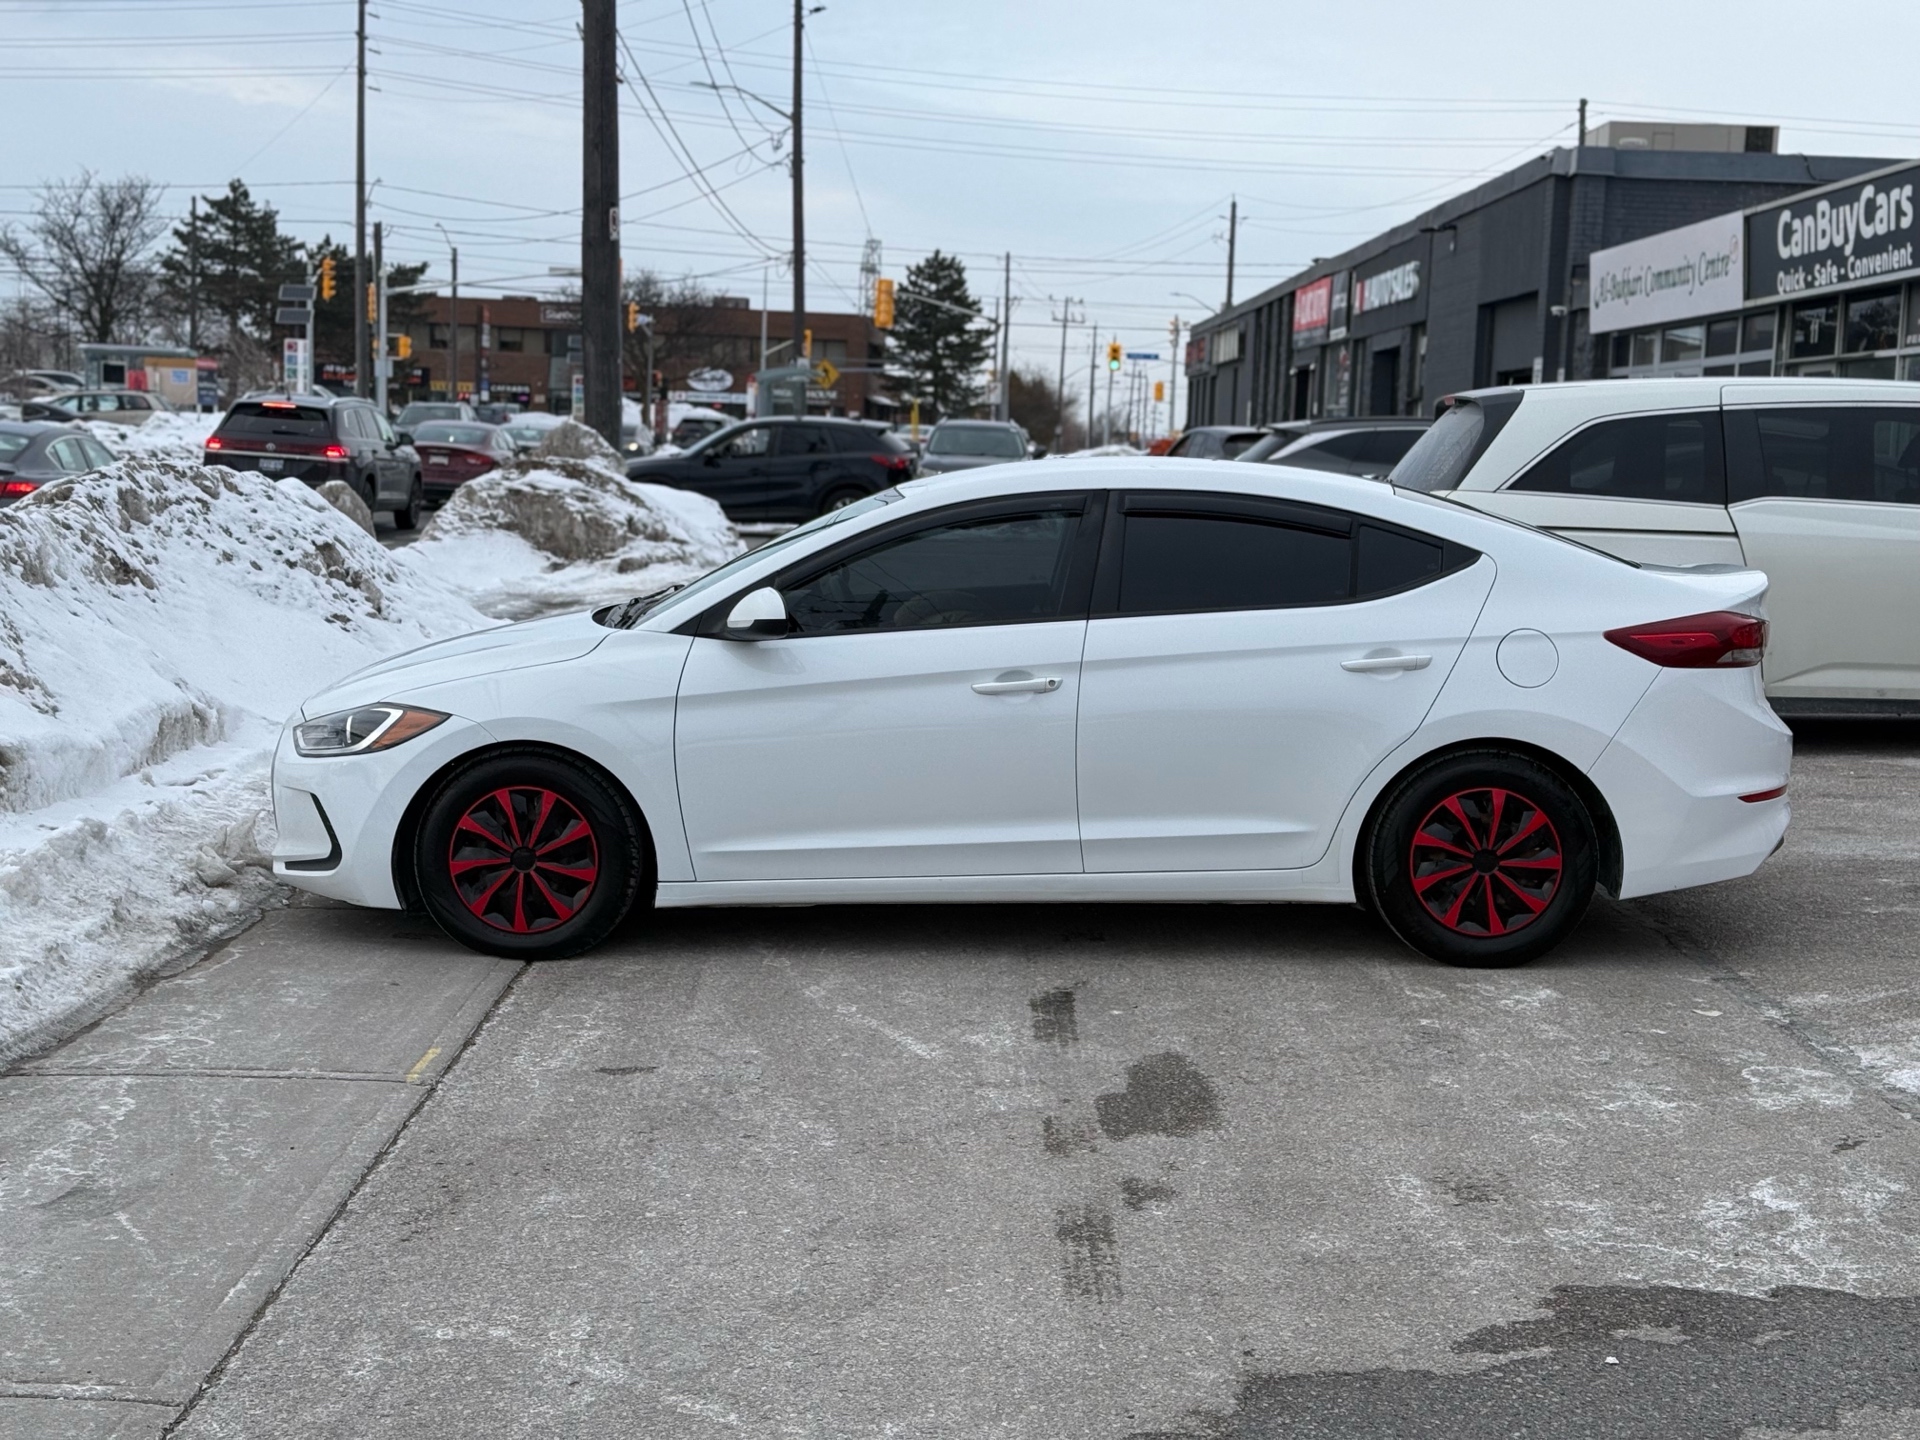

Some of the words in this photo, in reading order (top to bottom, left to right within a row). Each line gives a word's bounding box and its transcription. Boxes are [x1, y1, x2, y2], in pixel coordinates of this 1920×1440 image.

[1777, 184, 1913, 260] CanBuyCars
[1644, 254, 1696, 297] Community
[1698, 252, 1731, 286] Centre
[1777, 266, 1806, 295] Quick
[1814, 259, 1838, 287] Safe
[1847, 242, 1913, 279] Convenient
